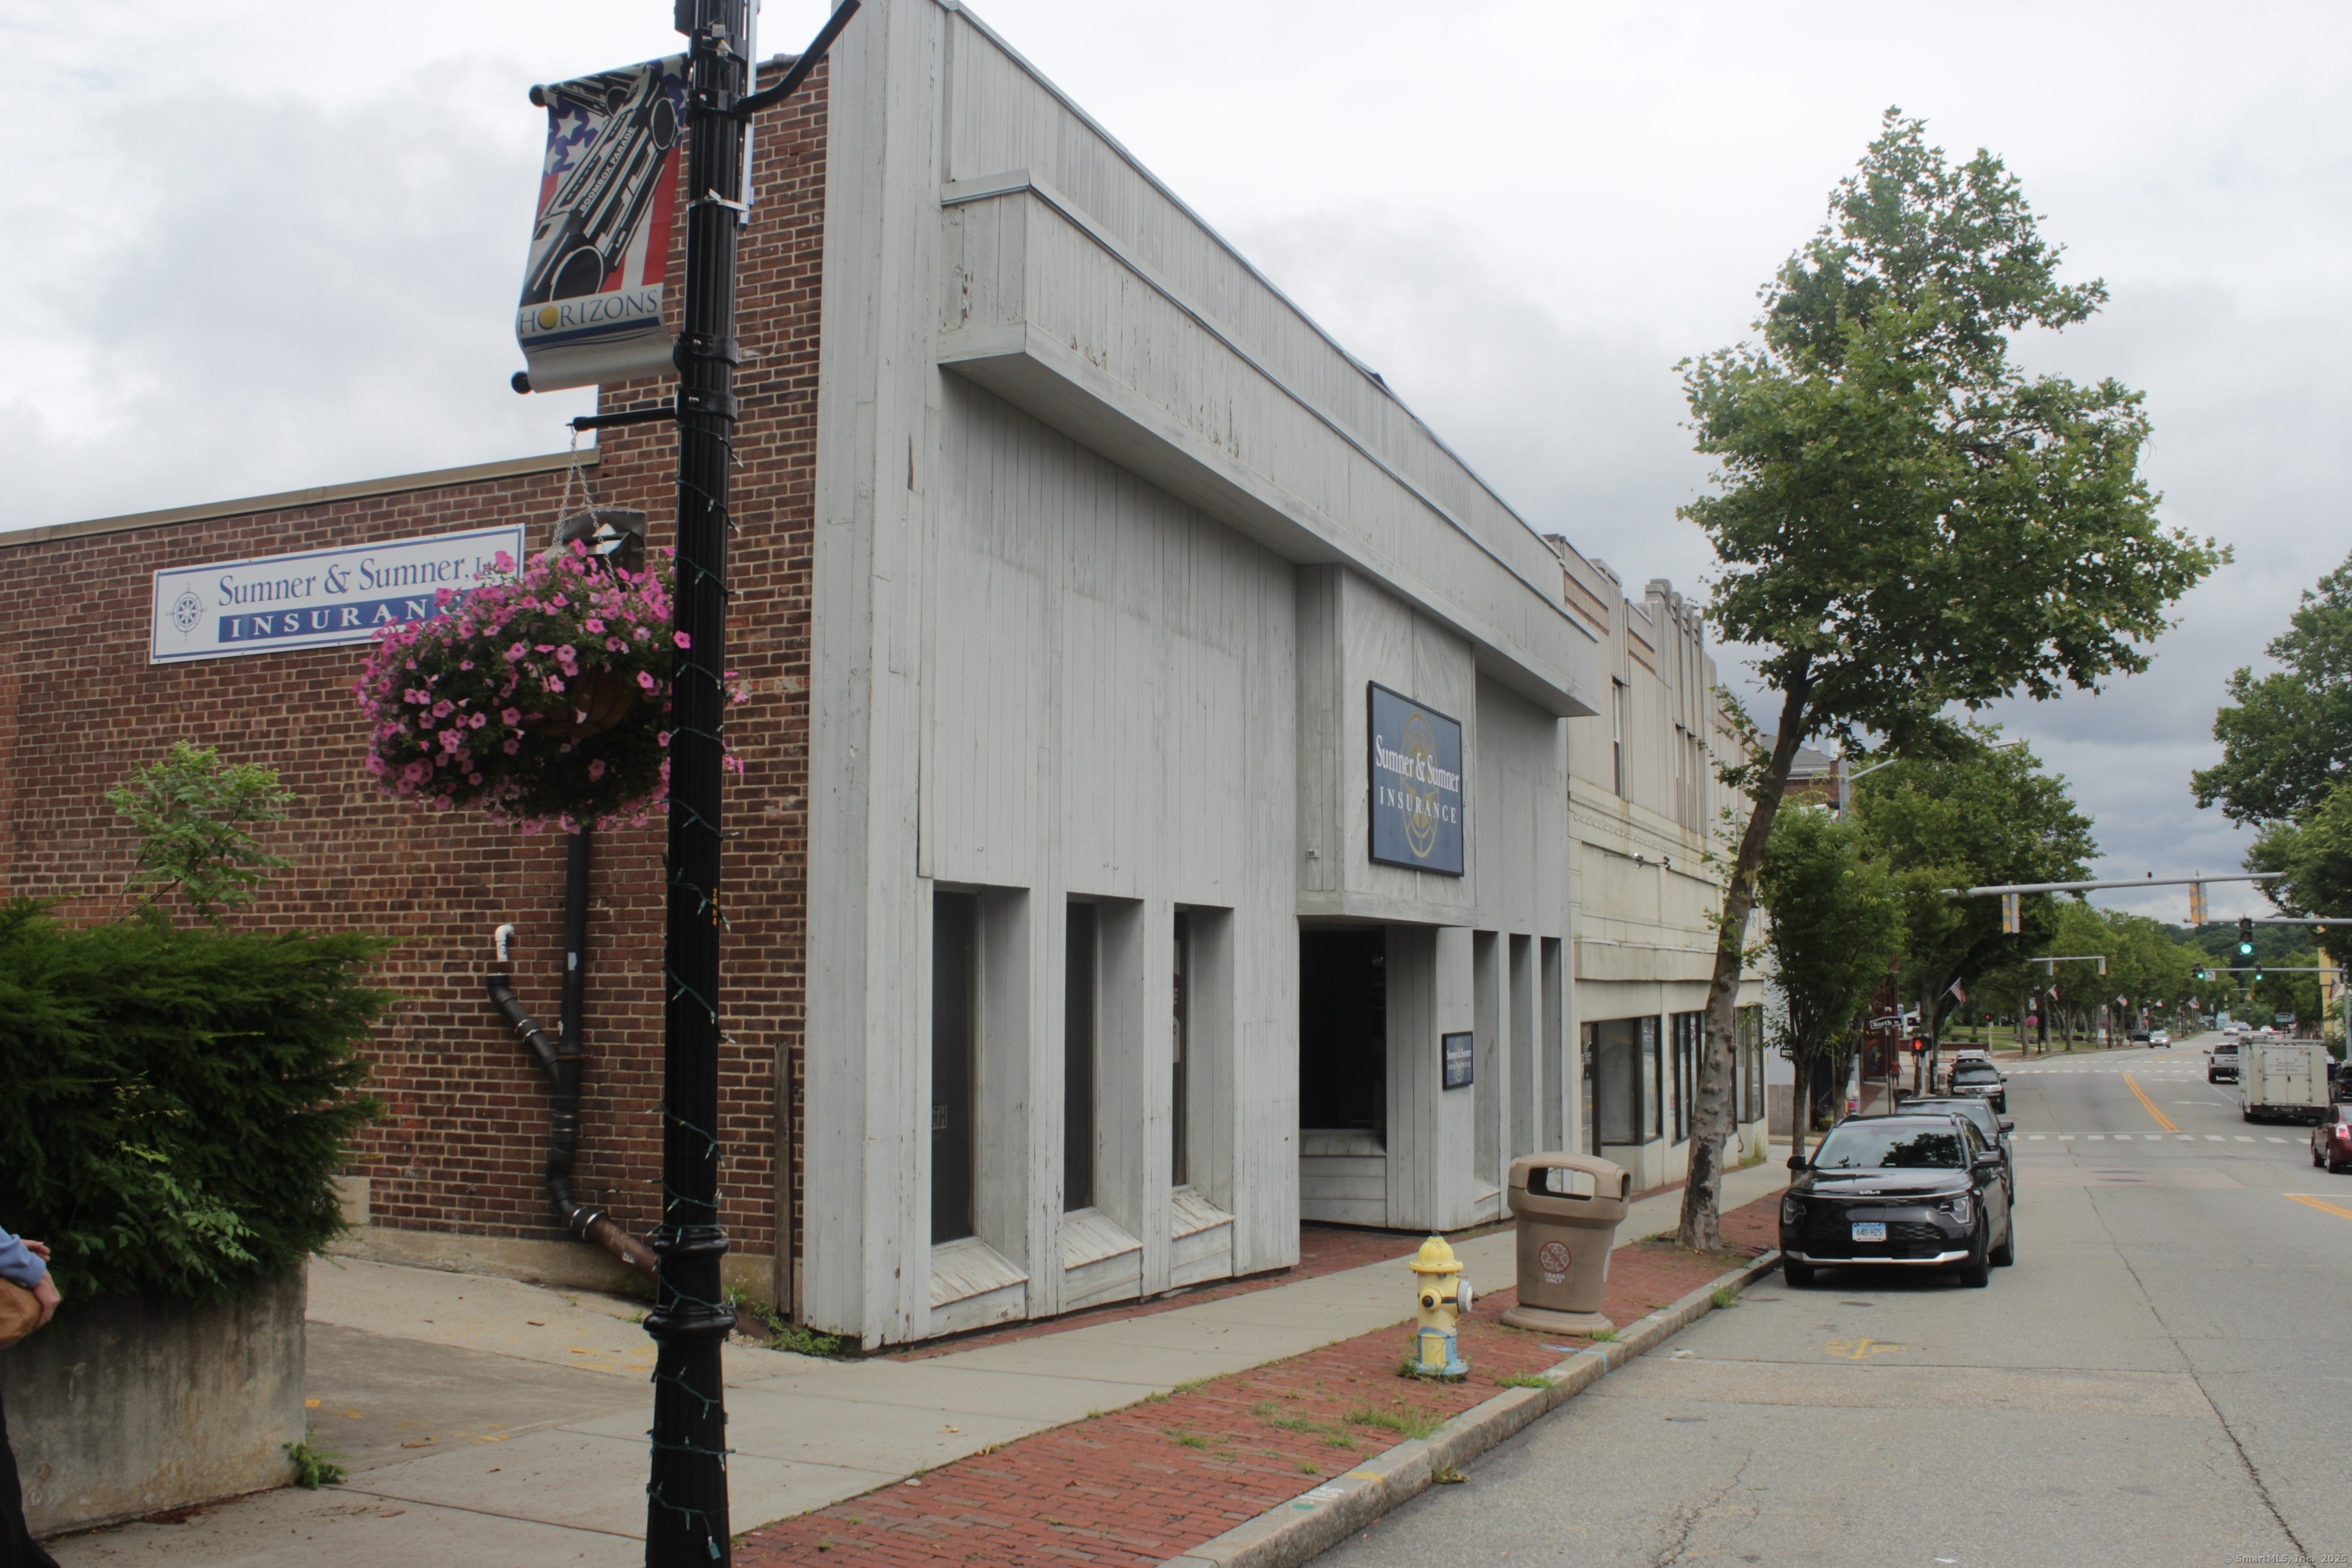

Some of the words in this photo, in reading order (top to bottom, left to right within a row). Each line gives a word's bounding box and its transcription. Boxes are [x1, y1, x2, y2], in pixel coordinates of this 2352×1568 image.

[579, 165, 612, 212] BOOMBOX
[610, 126, 635, 165] PARADE
[520, 290, 658, 334] HORIZONS
[218, 575, 316, 606] Sumner
[324, 564, 351, 595] &
[1376, 734, 1413, 778] Sumner
[1416, 752, 1425, 782] &
[1427, 754, 1459, 793] Sumner
[1380, 786, 1456, 825] INSURANCE
